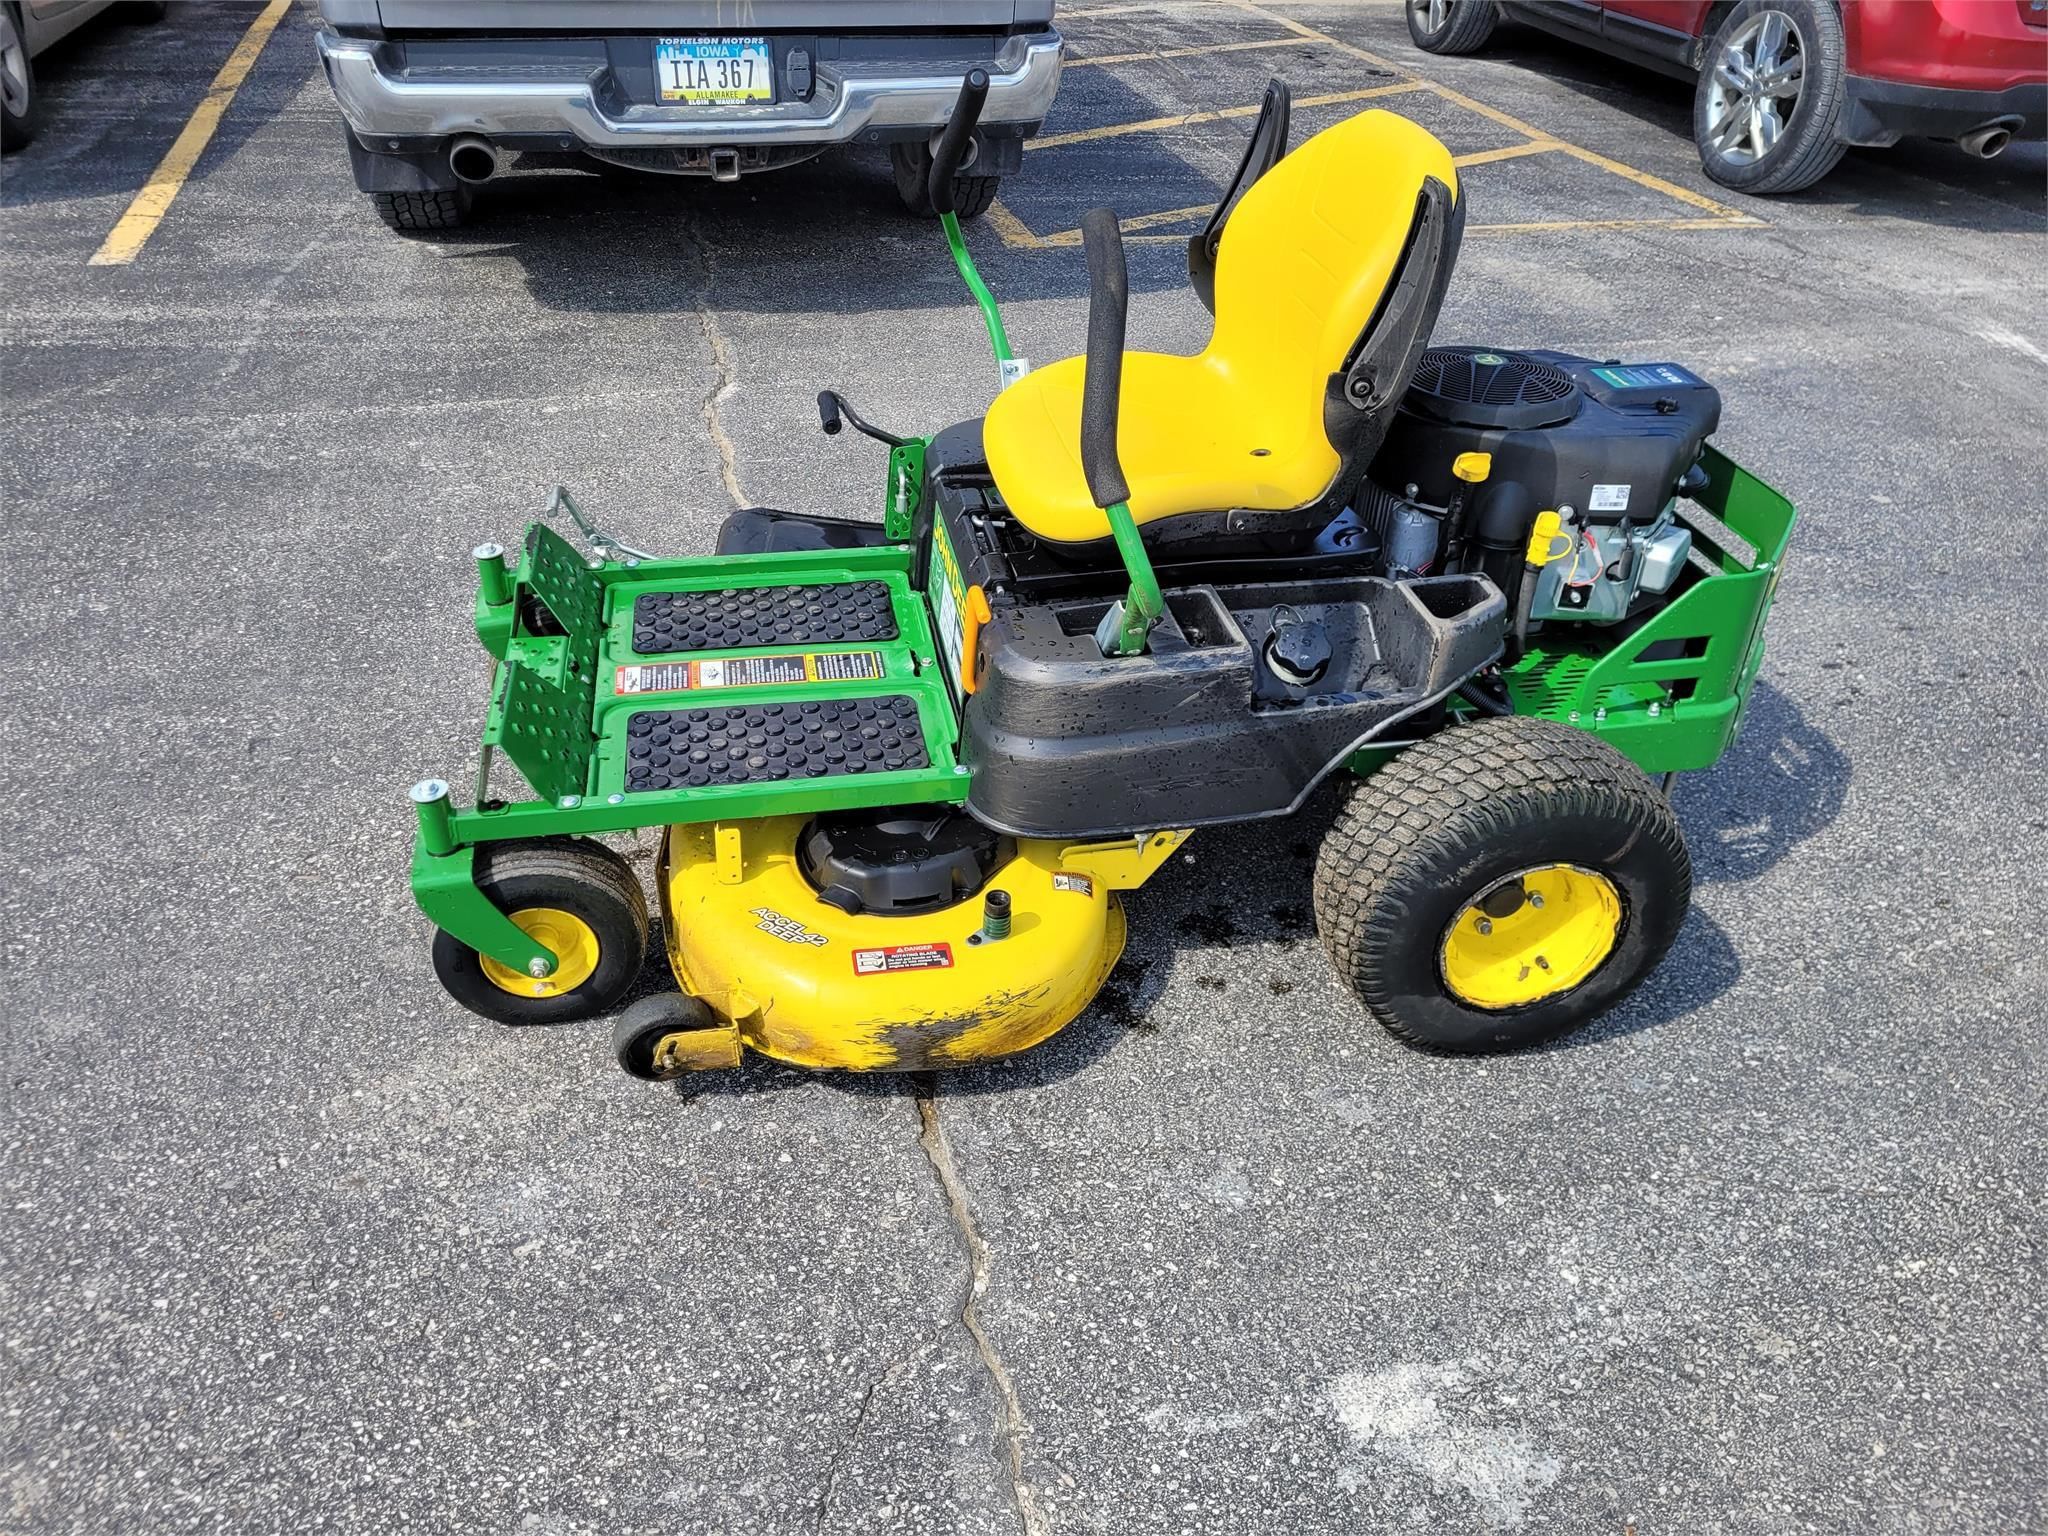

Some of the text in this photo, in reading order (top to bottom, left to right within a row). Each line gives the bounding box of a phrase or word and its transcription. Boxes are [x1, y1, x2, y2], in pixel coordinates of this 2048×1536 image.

[696, 46, 730, 57] IOWA
[670, 59, 754, 89] IIA 367
[696, 90, 739, 99] ALLAMAKEE
[749, 907, 829, 947] ACCEL 42
[755, 920, 807, 943] DEEP
